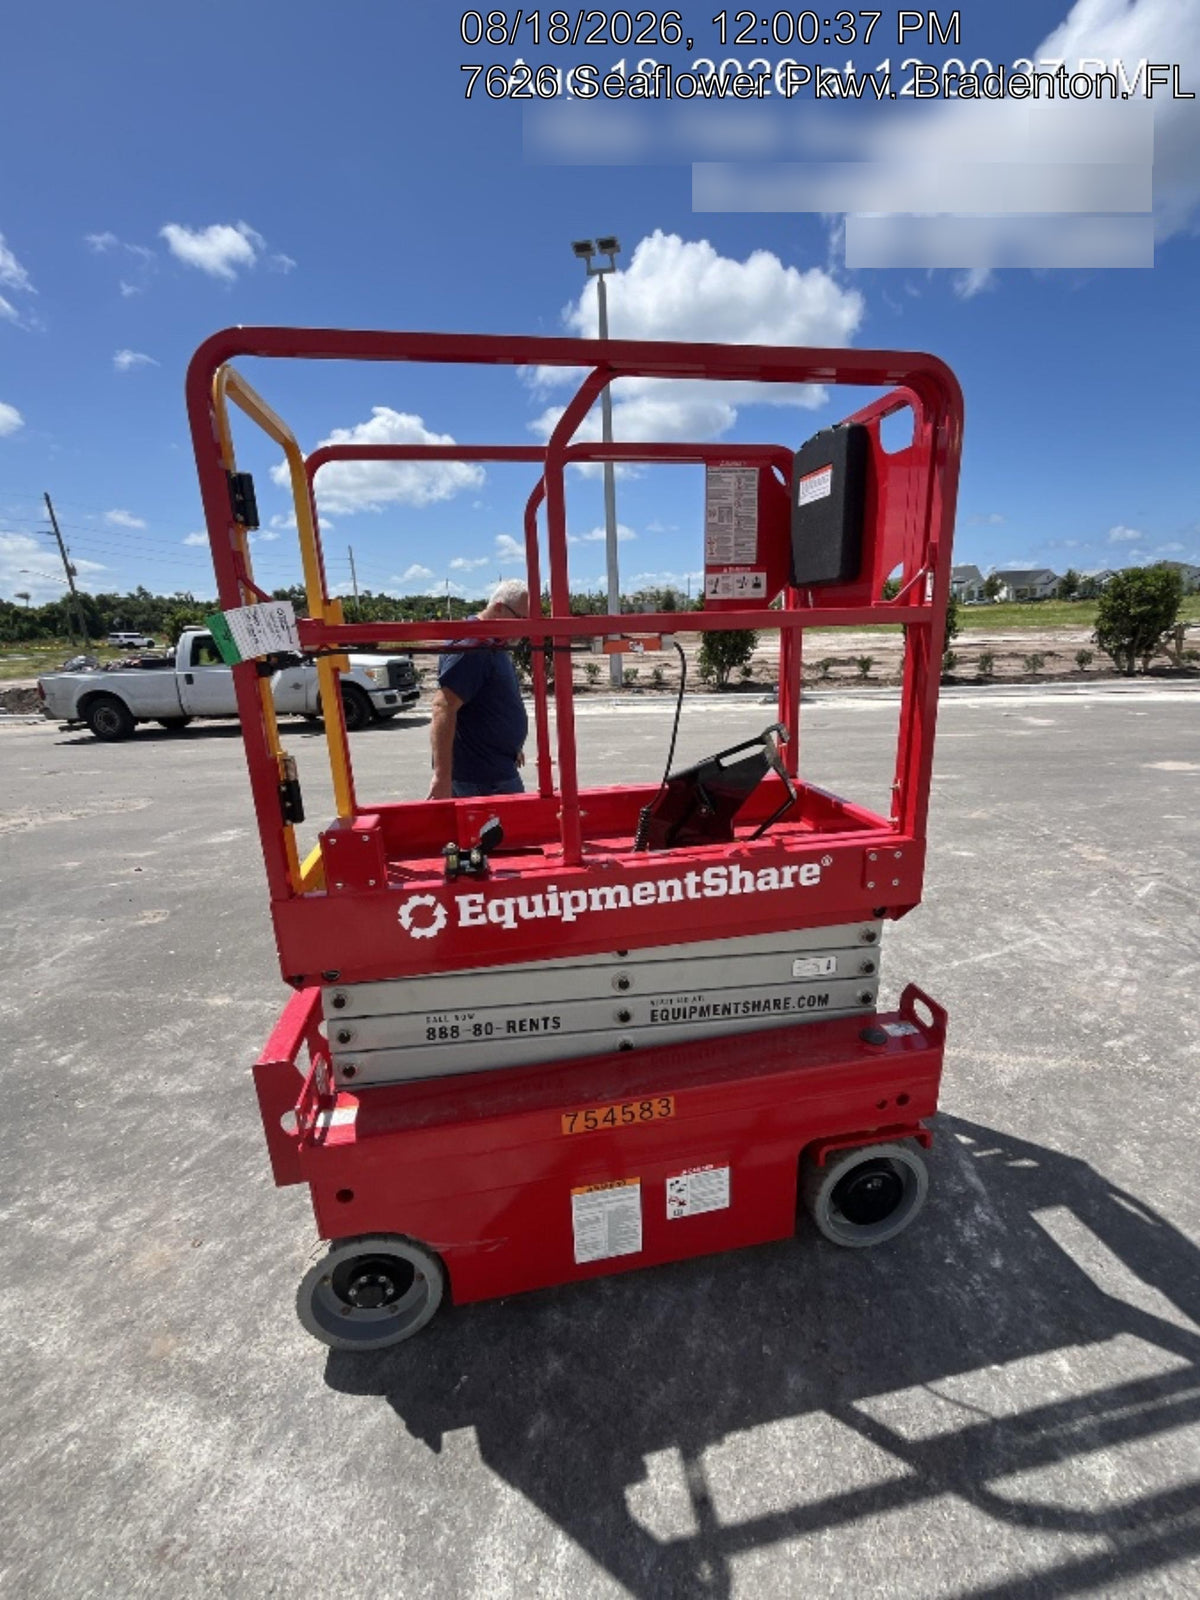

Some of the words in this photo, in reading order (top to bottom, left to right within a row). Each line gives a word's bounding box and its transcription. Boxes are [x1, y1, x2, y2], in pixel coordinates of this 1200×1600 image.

[650, 994, 830, 1023] EQUIPMENTSHARE.COM
[426, 1016, 561, 1041] 888-80-RENTS
[564, 1097, 673, 1133] 754583
